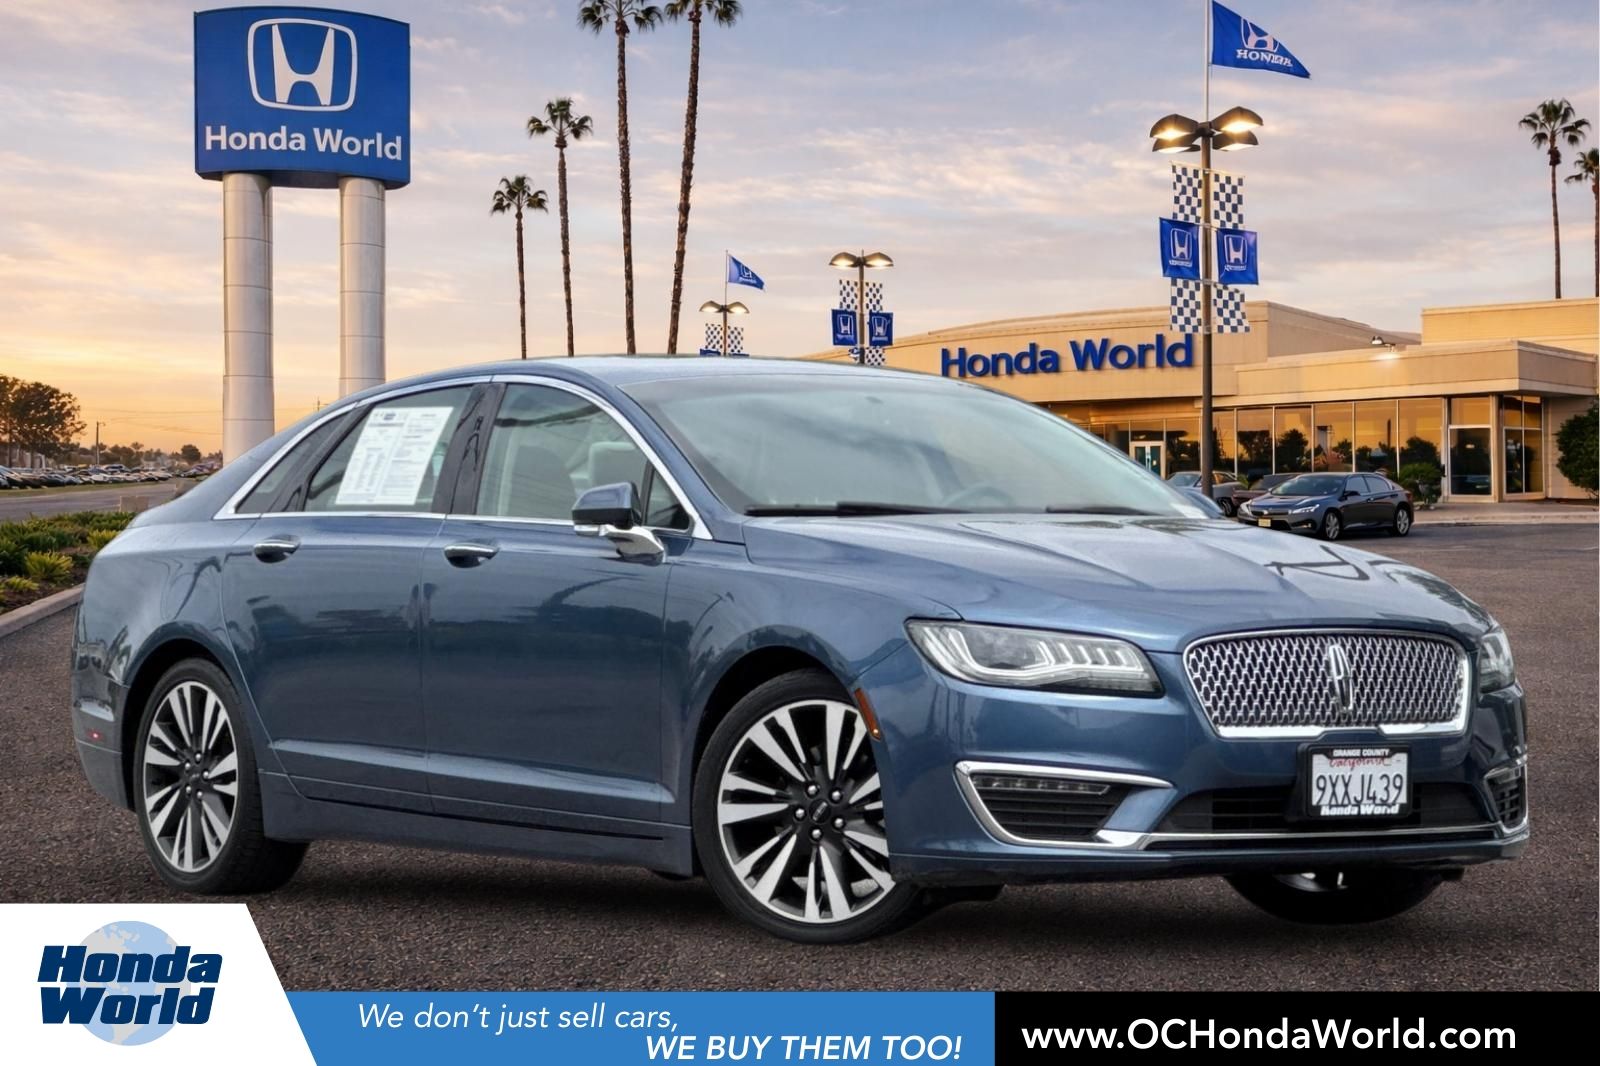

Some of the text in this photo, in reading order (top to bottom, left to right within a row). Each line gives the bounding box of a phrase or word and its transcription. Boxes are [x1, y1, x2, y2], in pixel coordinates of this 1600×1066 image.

[205, 125, 402, 160] Honda World
[941, 333, 1194, 378] Honda World
[1333, 749, 1390, 757] ORANGE COUNTY
[1316, 773, 1403, 805] 9XXJ439
[1320, 803, 1400, 816] Honda World
